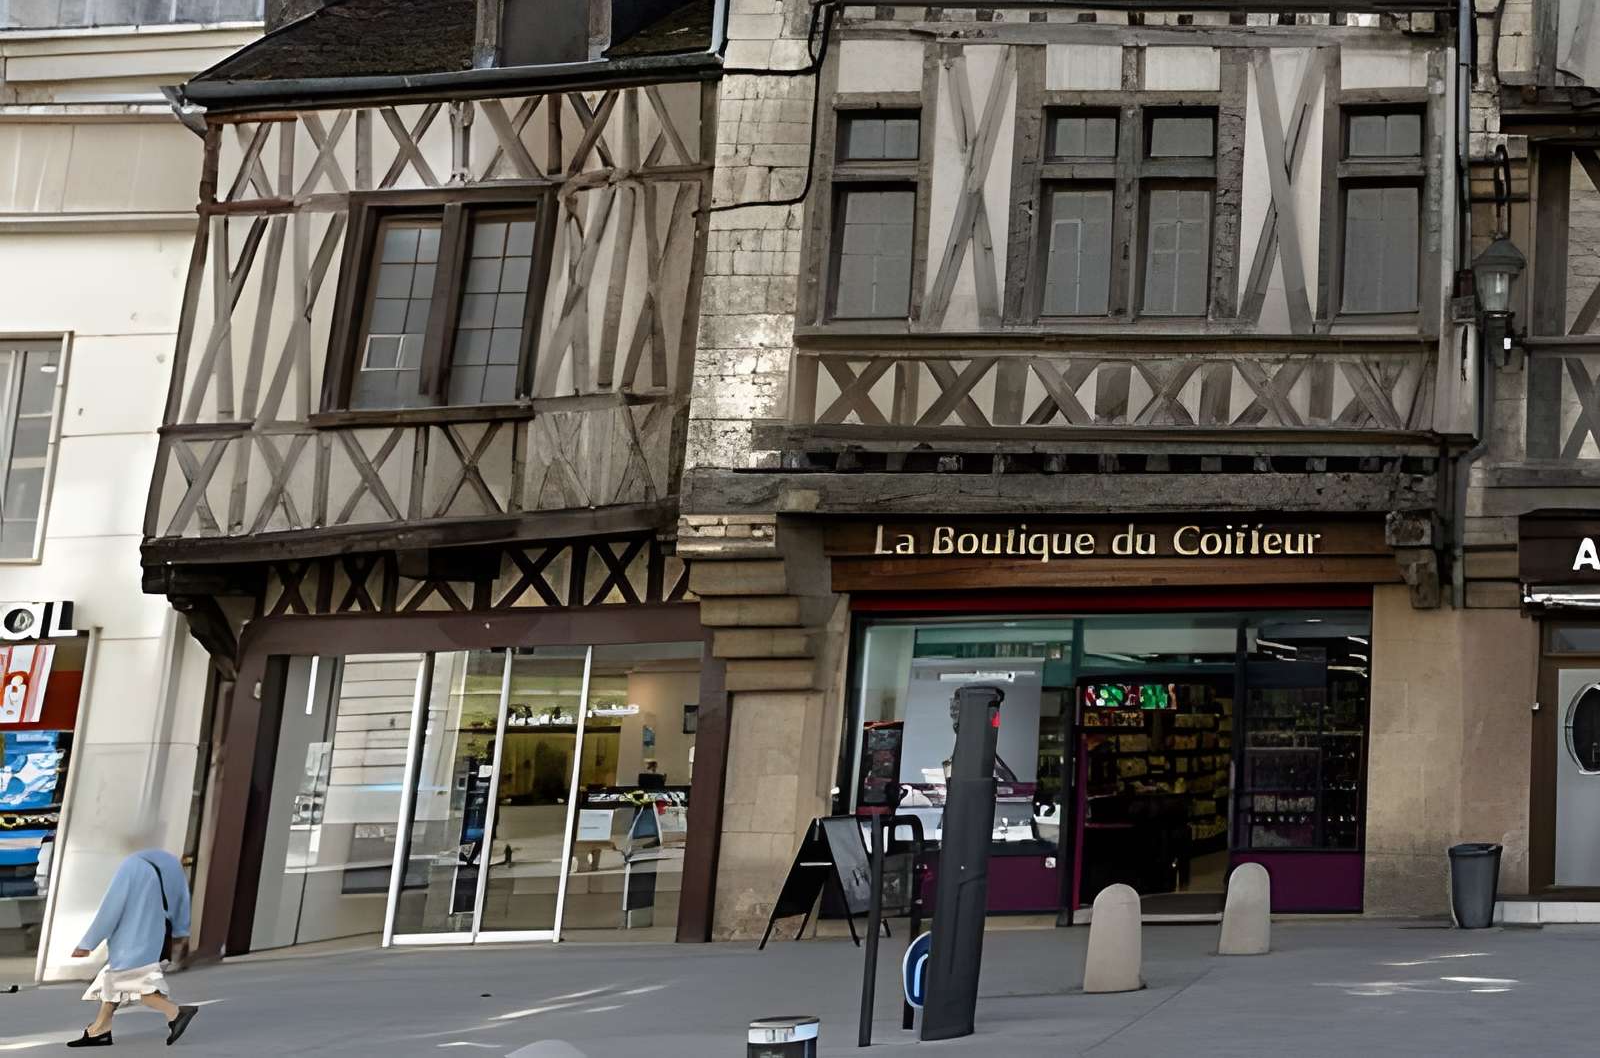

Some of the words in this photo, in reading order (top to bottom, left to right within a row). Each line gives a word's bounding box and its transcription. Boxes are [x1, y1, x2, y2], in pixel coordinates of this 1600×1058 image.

[874, 525, 915, 555] La
[932, 525, 1095, 562] Boutique
[1112, 523, 1156, 555] du
